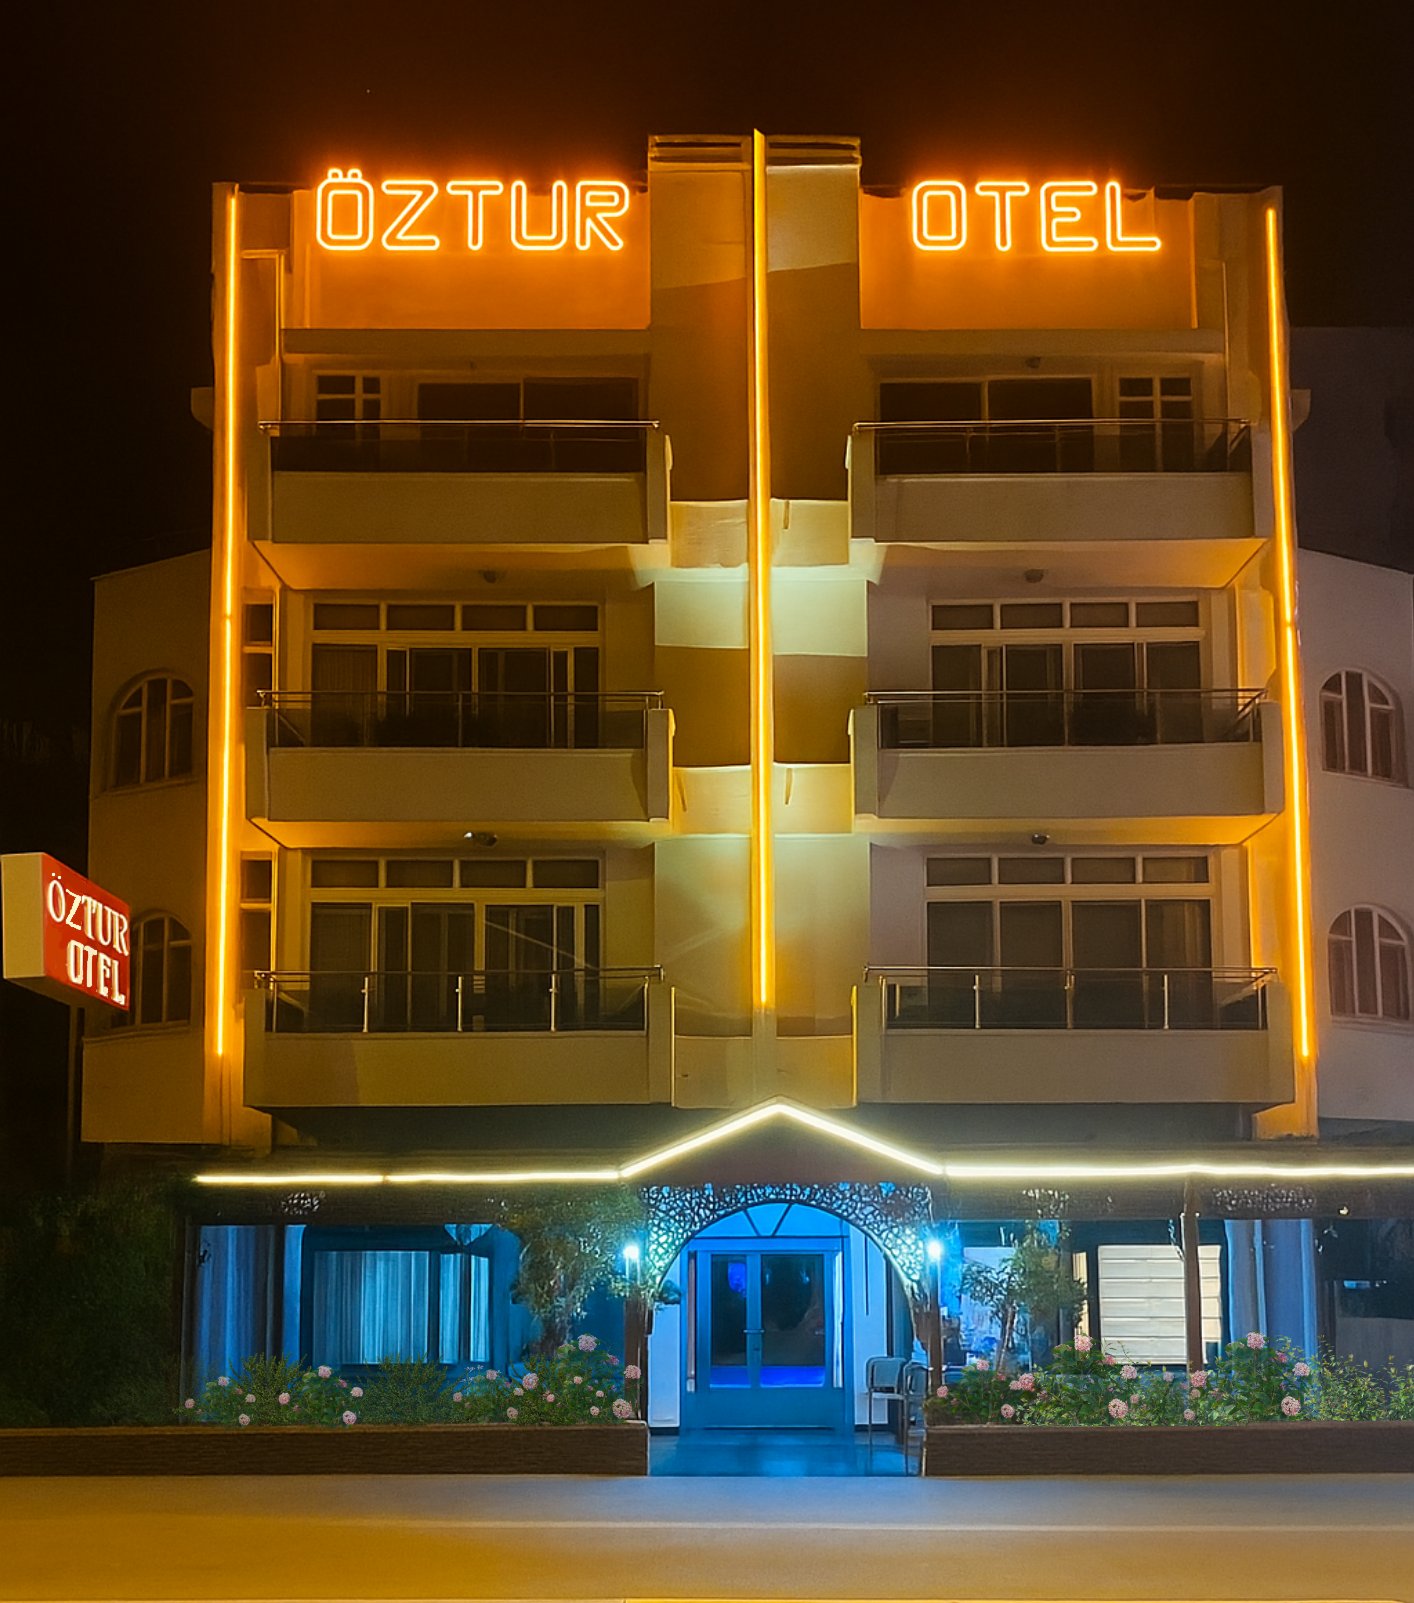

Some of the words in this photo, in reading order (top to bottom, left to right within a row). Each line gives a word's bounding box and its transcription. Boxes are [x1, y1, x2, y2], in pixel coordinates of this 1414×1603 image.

[315, 167, 630, 252] ÖZTUR
[911, 180, 1163, 252] OTEL
[47, 872, 130, 957] ÖZTUR
[66, 939, 126, 1006] OTEL
